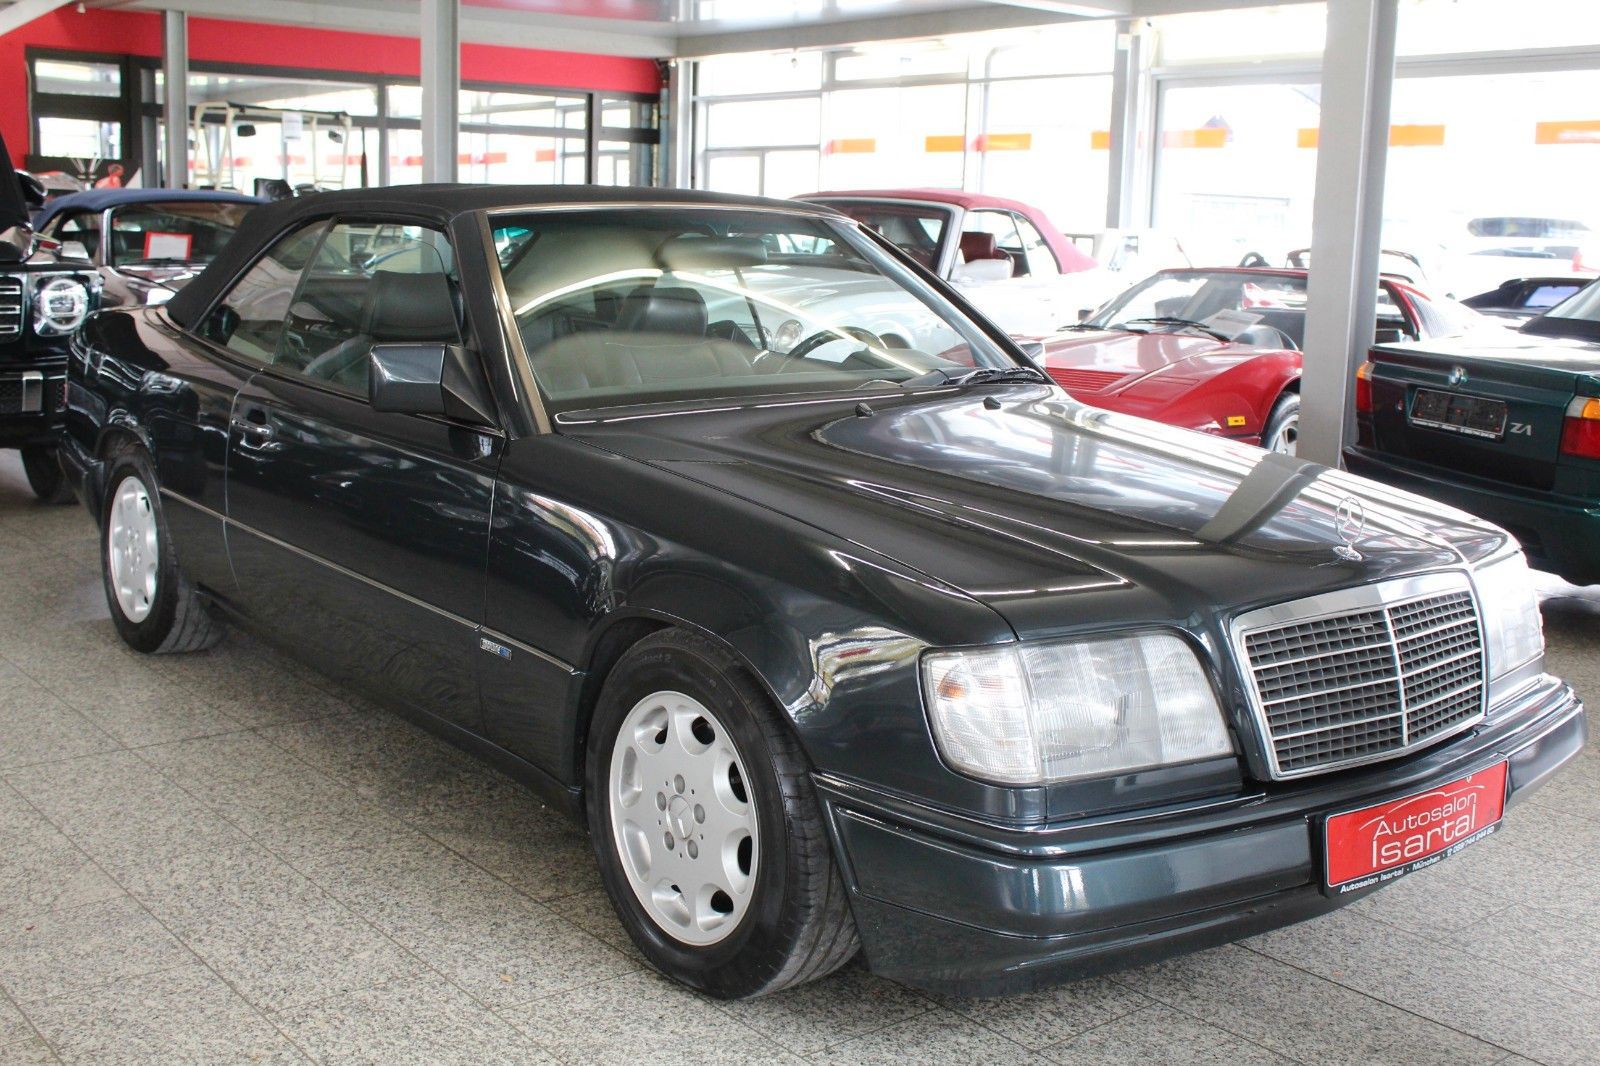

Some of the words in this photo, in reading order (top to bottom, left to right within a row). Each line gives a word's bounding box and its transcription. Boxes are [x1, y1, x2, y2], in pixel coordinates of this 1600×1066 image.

[1373, 804, 1476, 868] Isartal
[1374, 792, 1477, 839] Autosalon
[1340, 877, 1379, 894] Autosalon
[1380, 867, 1404, 882] Isartal
